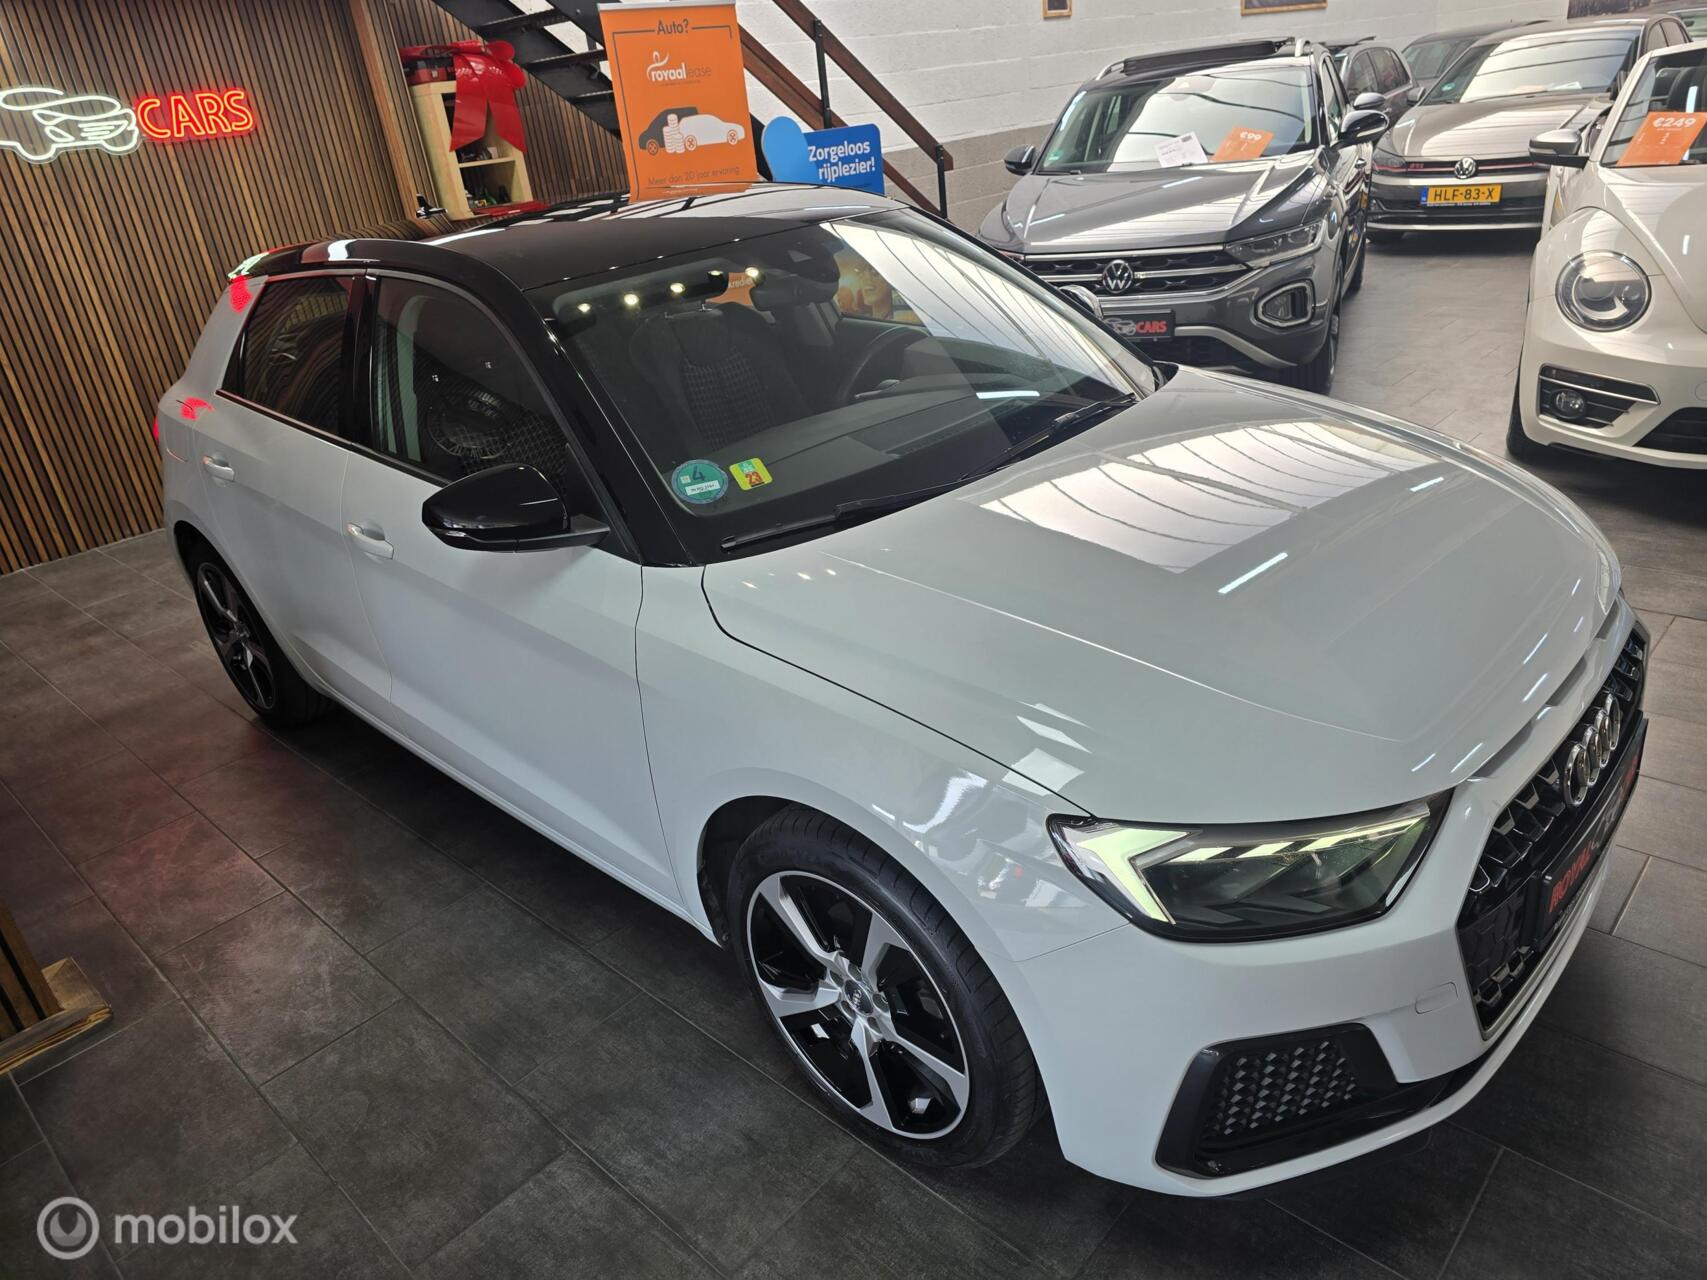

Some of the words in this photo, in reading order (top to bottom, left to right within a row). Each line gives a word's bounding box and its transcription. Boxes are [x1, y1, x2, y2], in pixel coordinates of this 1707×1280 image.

[657, 19, 689, 35] Auto?
[650, 62, 687, 82] royaal
[137, 90, 254, 139] CARS
[808, 140, 871, 163] Zorgeloos
[818, 156, 876, 183] rijplezier!
[1433, 187, 1496, 202] HLF-83-X
[1136, 320, 1168, 334] CARS
